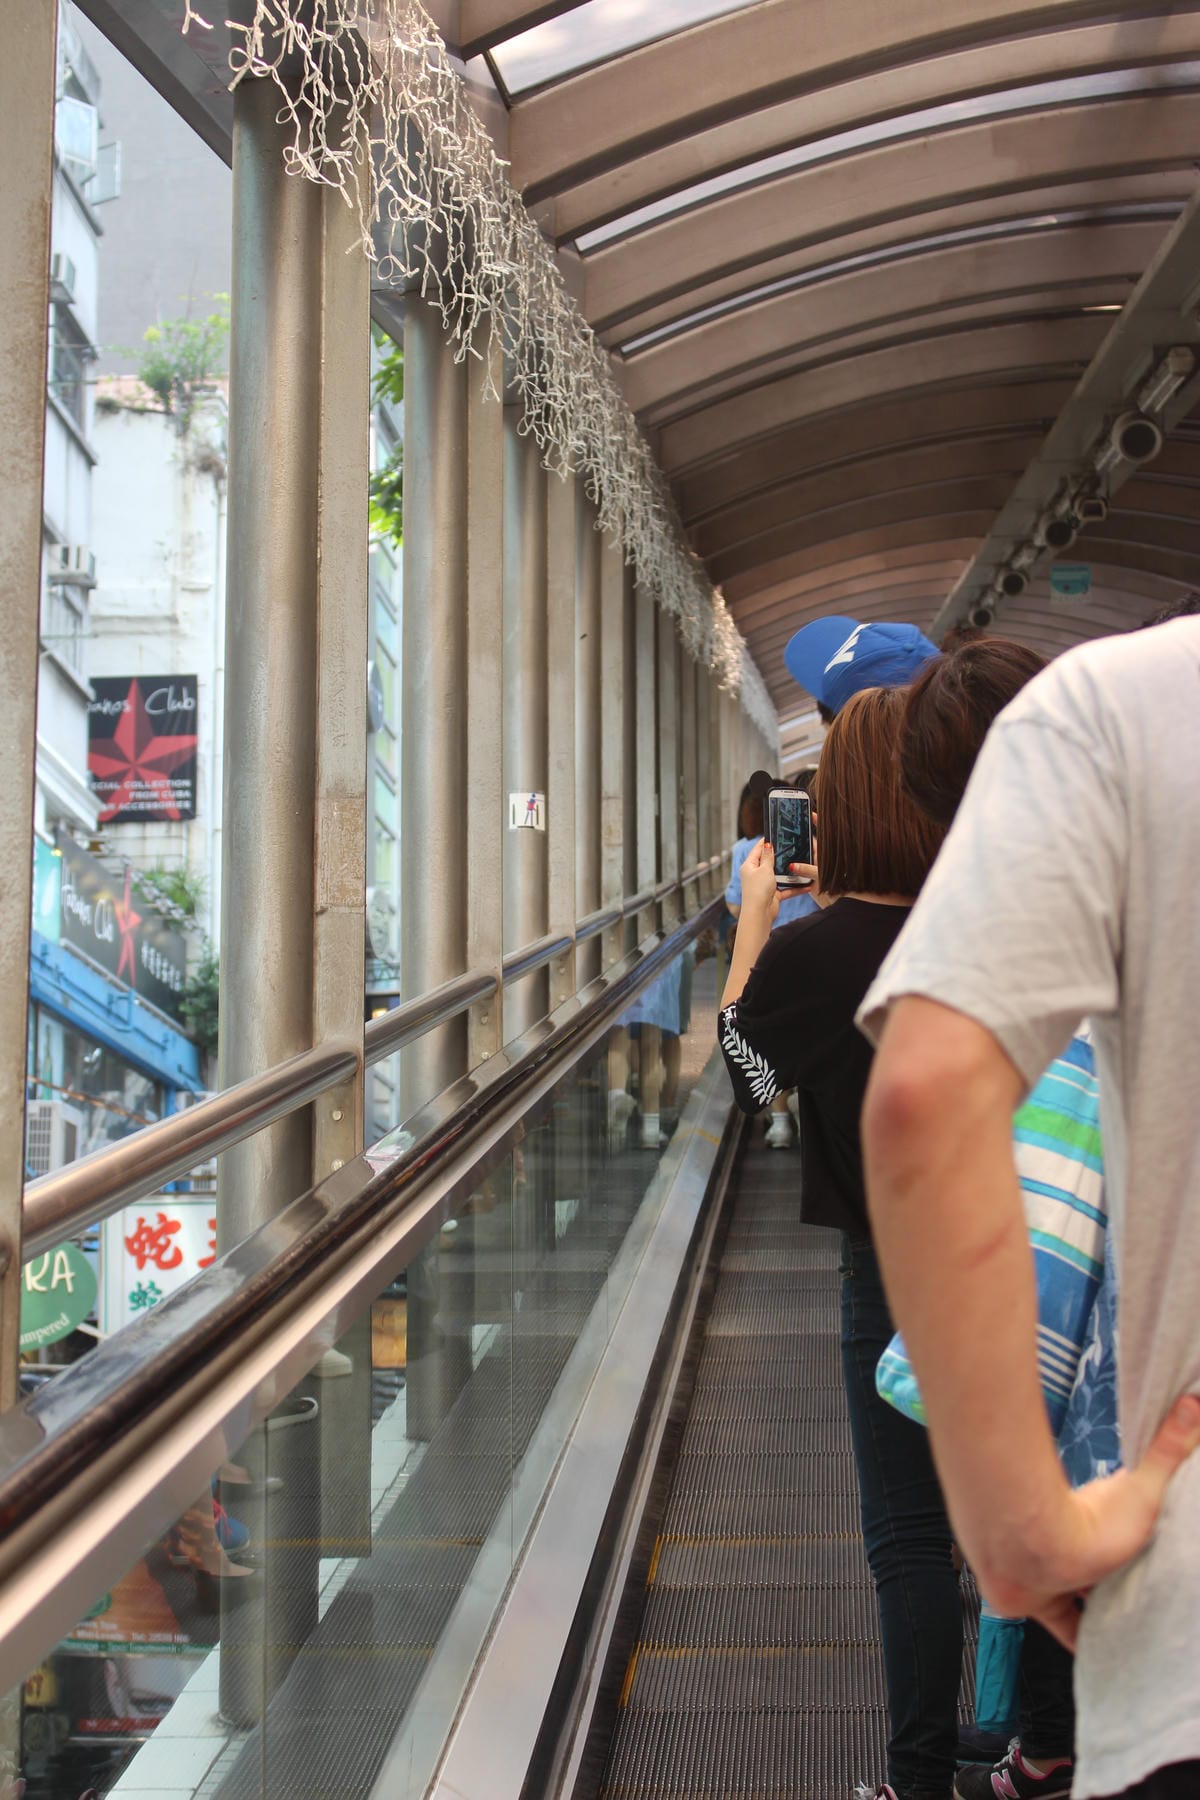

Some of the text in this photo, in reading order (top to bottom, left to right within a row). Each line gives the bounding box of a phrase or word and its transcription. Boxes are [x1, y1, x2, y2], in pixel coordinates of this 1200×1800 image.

[145, 685, 196, 714] Club
[123, 779, 191, 790] COLLECTION
[129, 789, 191, 800] FROM CUBA
[119, 800, 191, 811] ACCESSORIES
